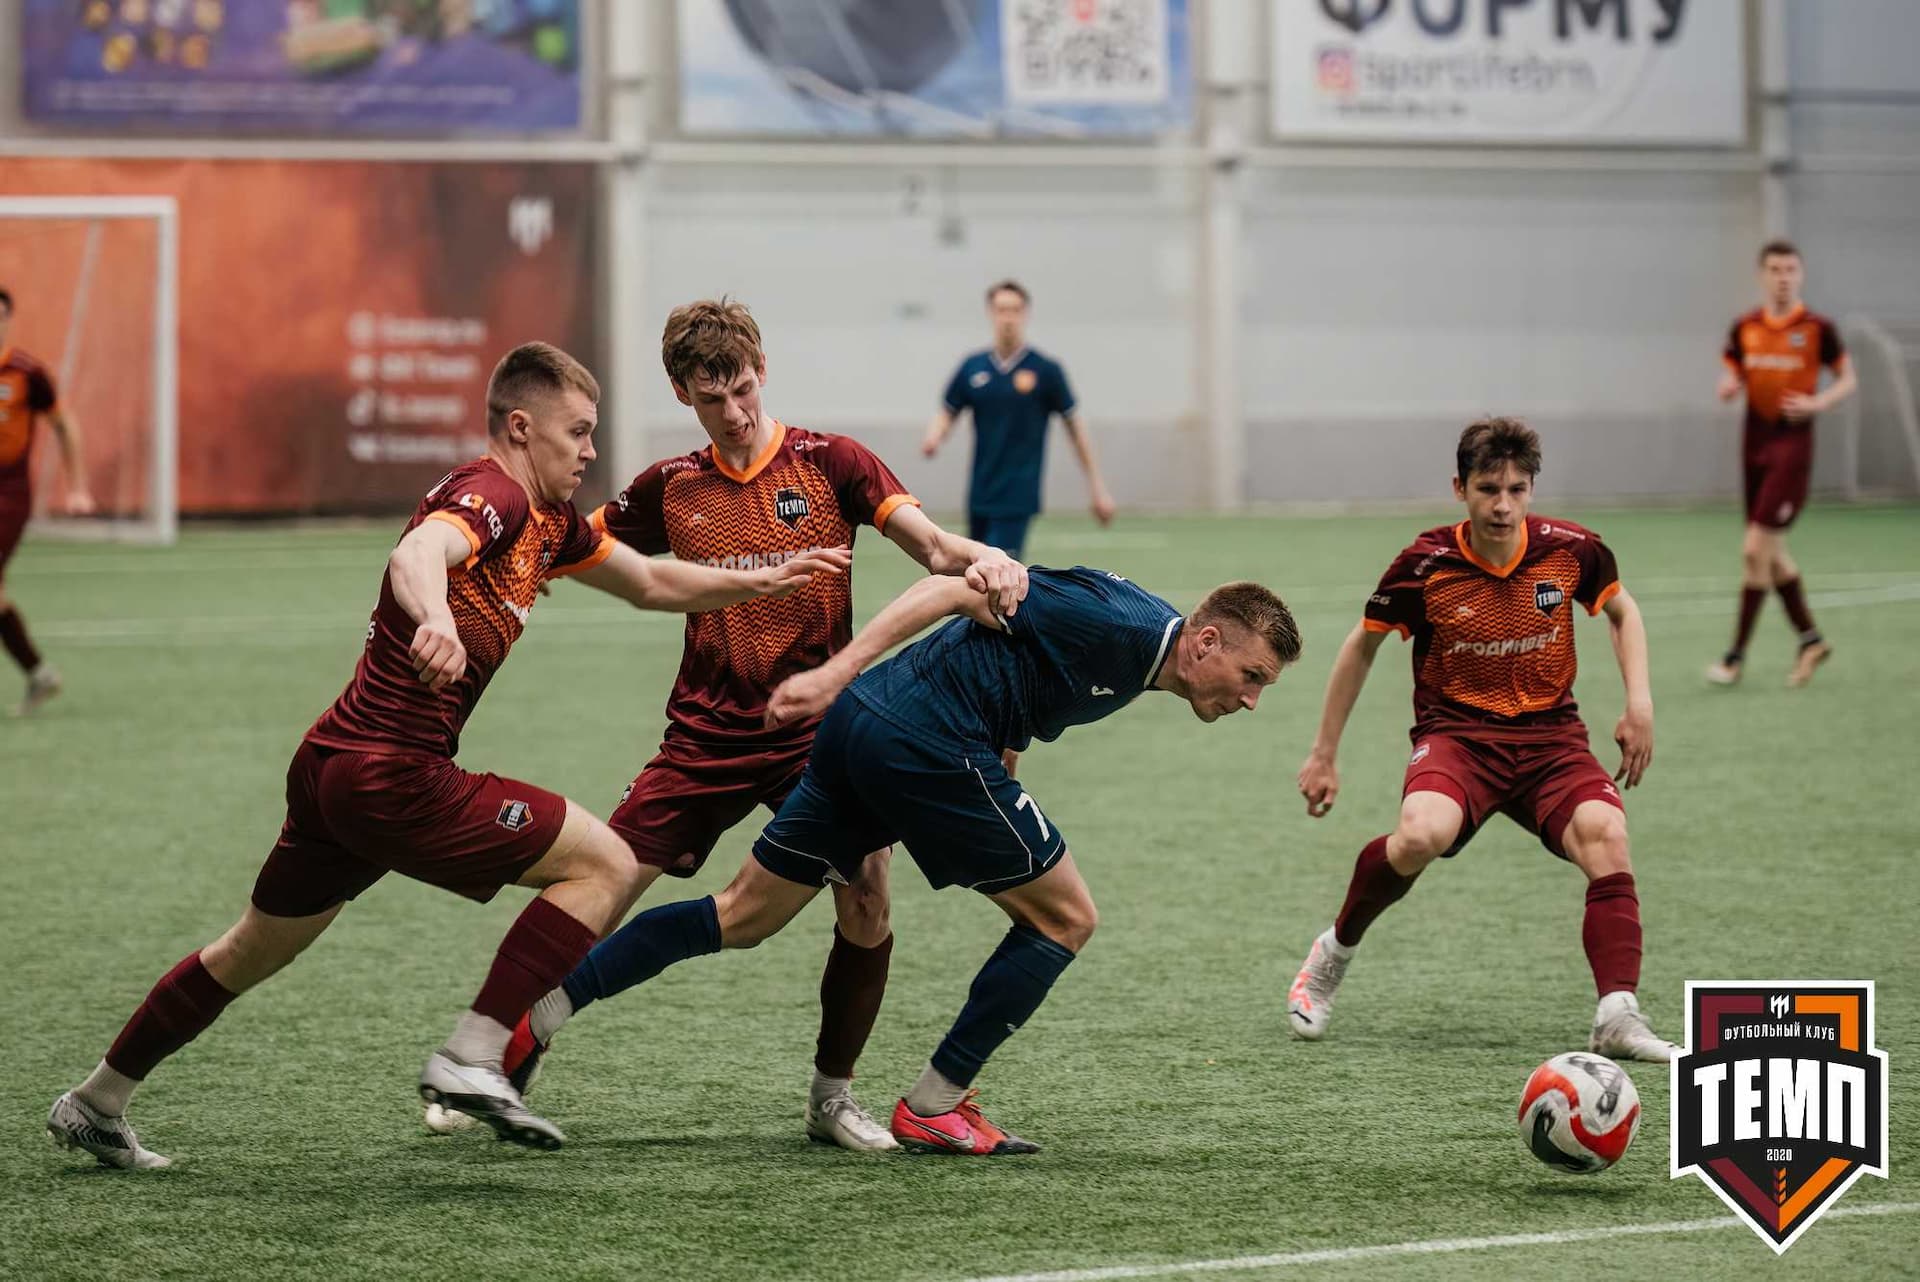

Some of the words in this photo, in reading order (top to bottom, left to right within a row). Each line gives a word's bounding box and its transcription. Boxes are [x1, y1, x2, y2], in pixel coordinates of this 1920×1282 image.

[777, 501, 807, 516] ТЕМП
[1537, 590, 1562, 607] ТЕМП
[1014, 791, 1051, 843] 7
